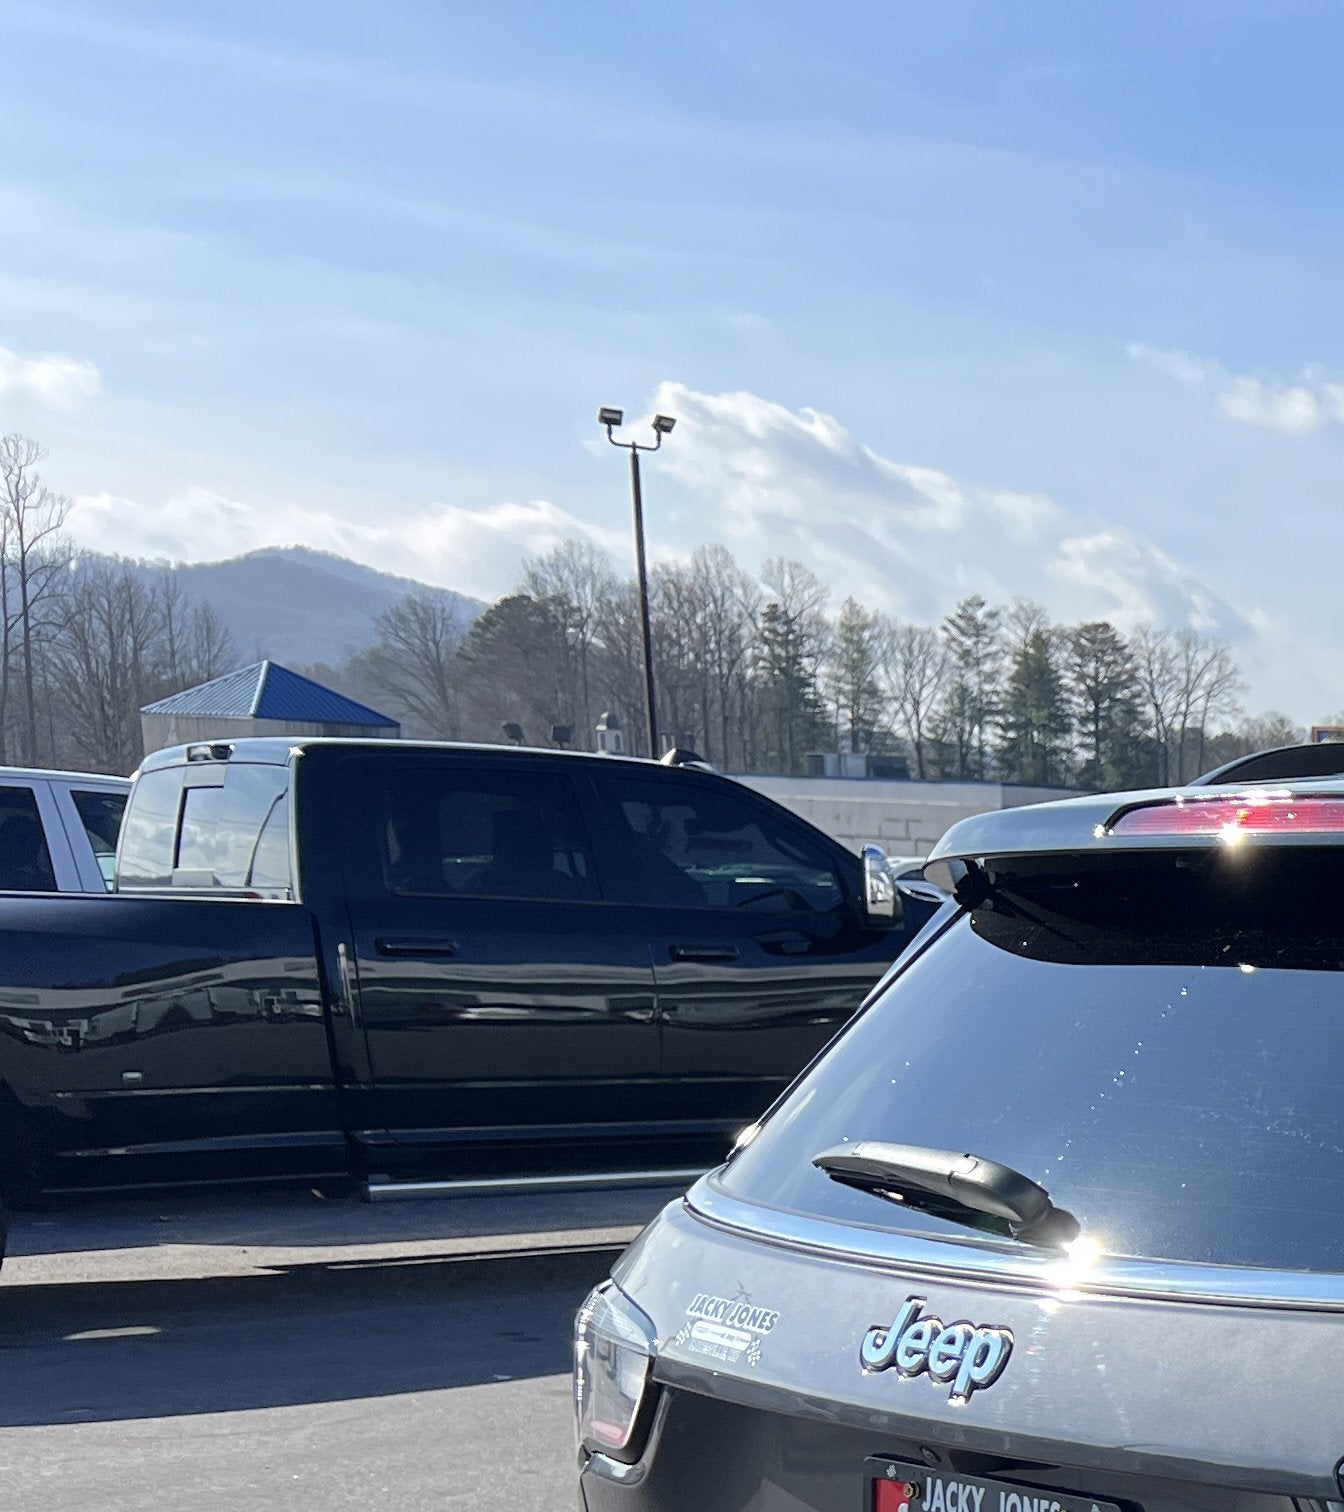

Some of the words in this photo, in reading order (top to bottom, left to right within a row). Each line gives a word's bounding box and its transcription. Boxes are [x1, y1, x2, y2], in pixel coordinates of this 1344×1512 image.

[687, 1293, 733, 1321] JACKY
[727, 1303, 780, 1333] JONES
[860, 1295, 1014, 1407] Jeep
